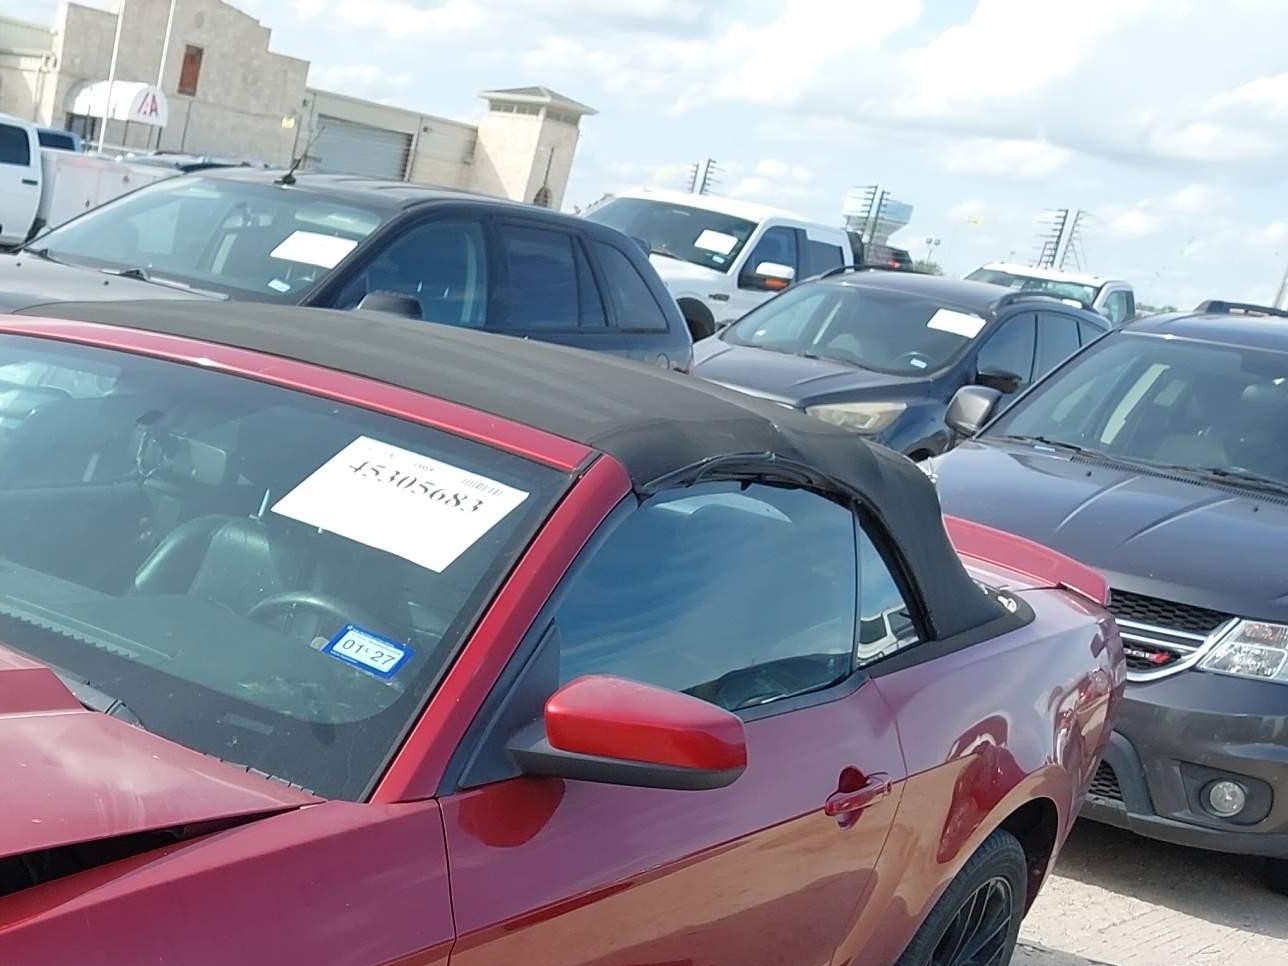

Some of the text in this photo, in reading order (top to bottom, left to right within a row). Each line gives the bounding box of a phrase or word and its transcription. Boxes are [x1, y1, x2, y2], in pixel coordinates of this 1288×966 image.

[349, 461, 484, 512] 45305683
[342, 639, 365, 654] 01
[369, 650, 396, 665] 27
